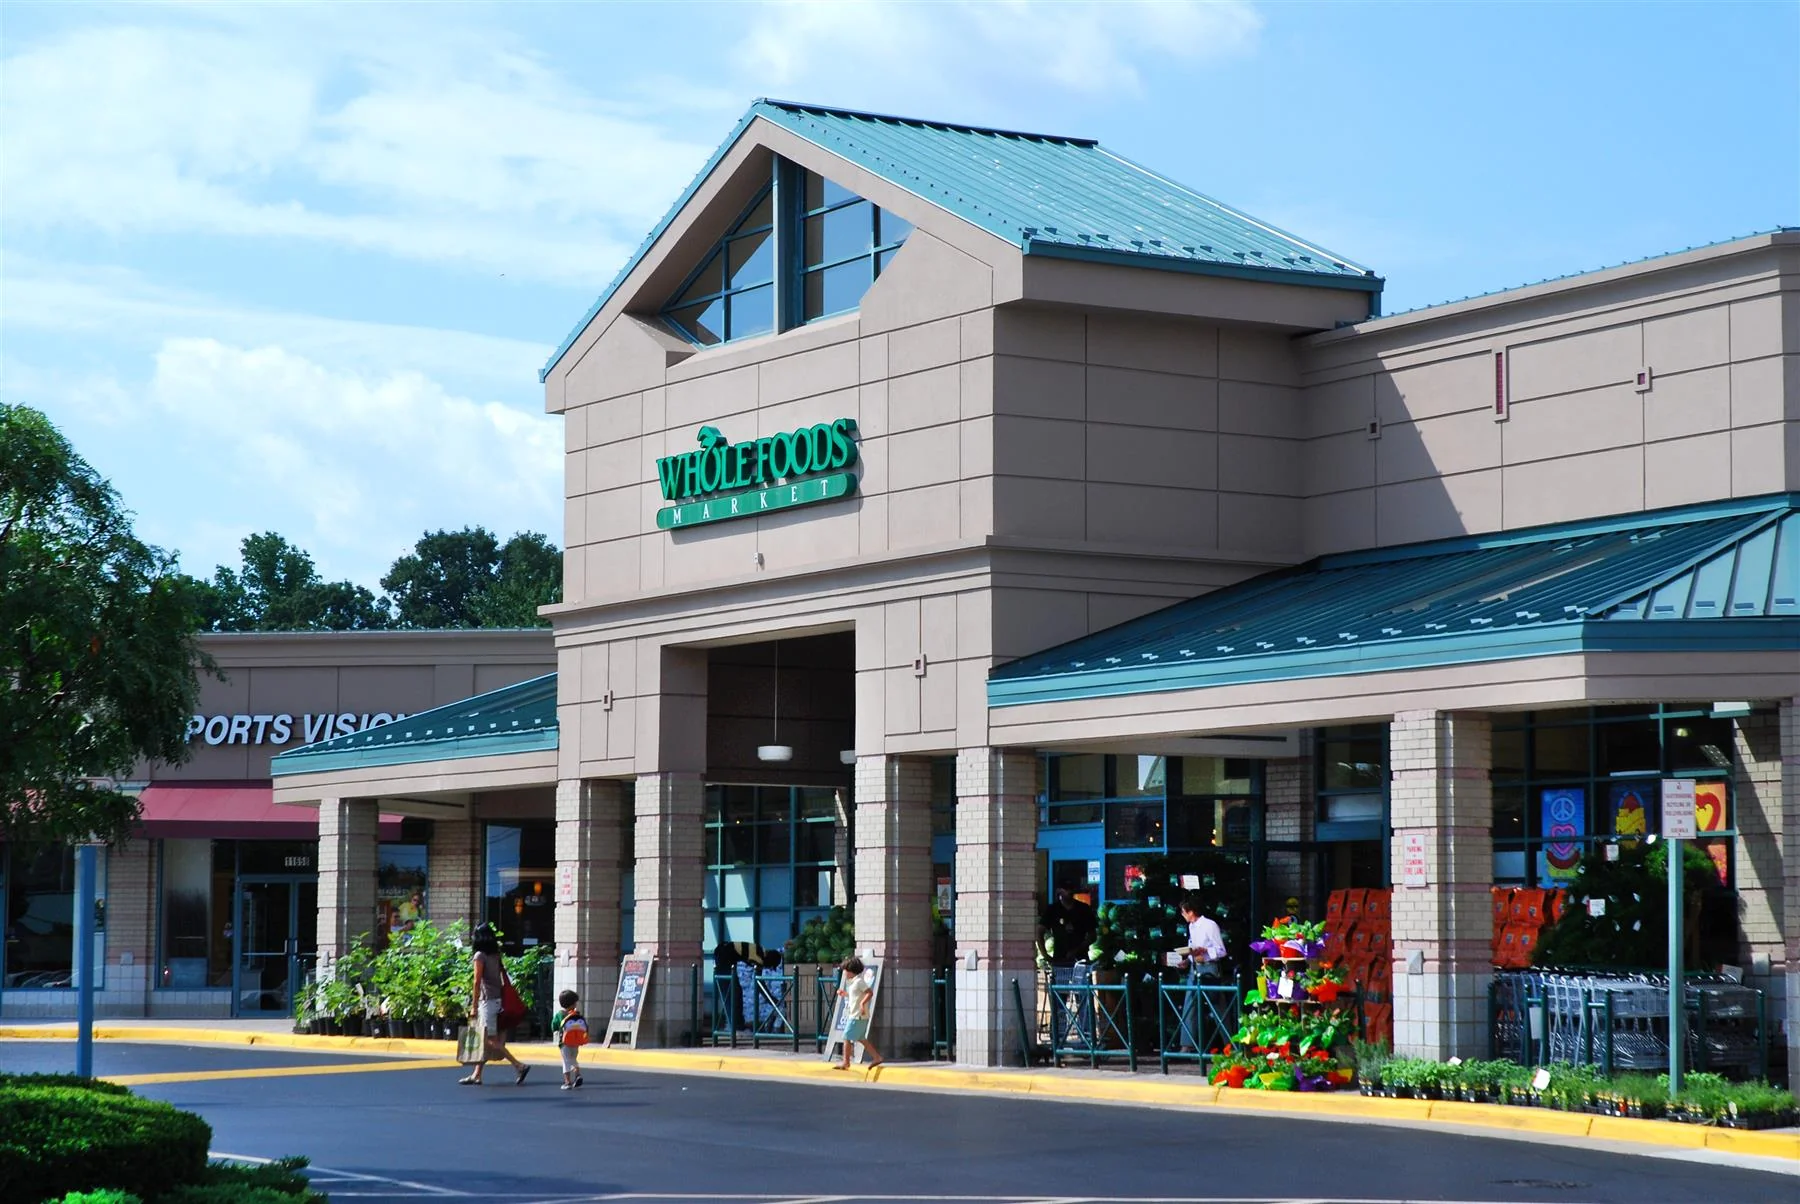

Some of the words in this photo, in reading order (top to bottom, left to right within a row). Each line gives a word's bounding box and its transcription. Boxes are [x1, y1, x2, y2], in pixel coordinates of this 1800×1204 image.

[656, 428, 754, 500] WHOLE
[756, 418, 857, 484] FOODS
[672, 479, 829, 525] MARKET
[184, 713, 294, 746] PORTS
[303, 713, 409, 743] VISI
